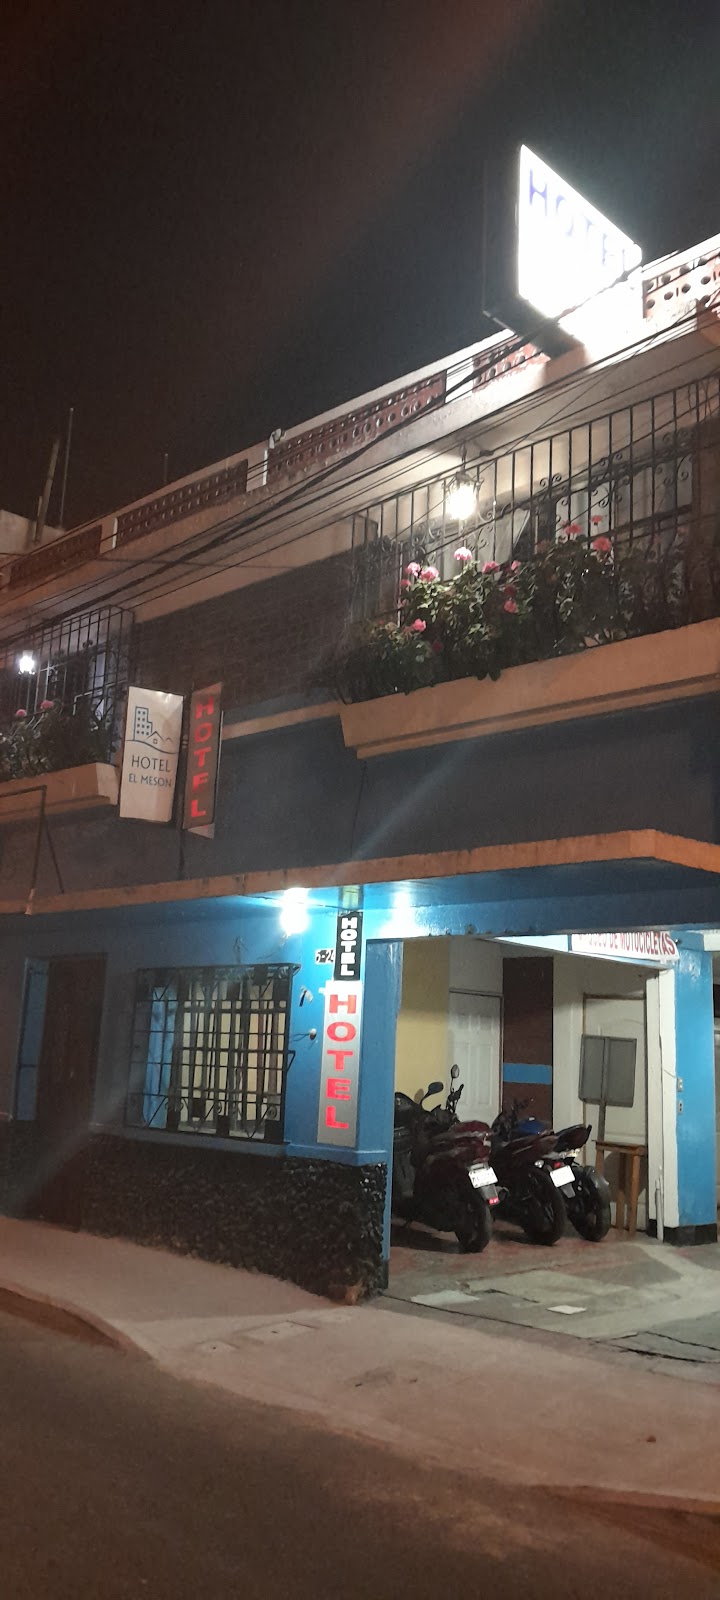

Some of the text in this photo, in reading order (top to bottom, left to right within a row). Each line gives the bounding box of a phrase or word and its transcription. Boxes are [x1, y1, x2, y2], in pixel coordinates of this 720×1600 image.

[128, 773, 172, 788] EL MESON
[131, 755, 171, 773] HOTEL
[191, 695, 215, 818] HOTEL
[340, 917, 358, 976] HOTEL
[326, 994, 358, 1129] HOTEL
